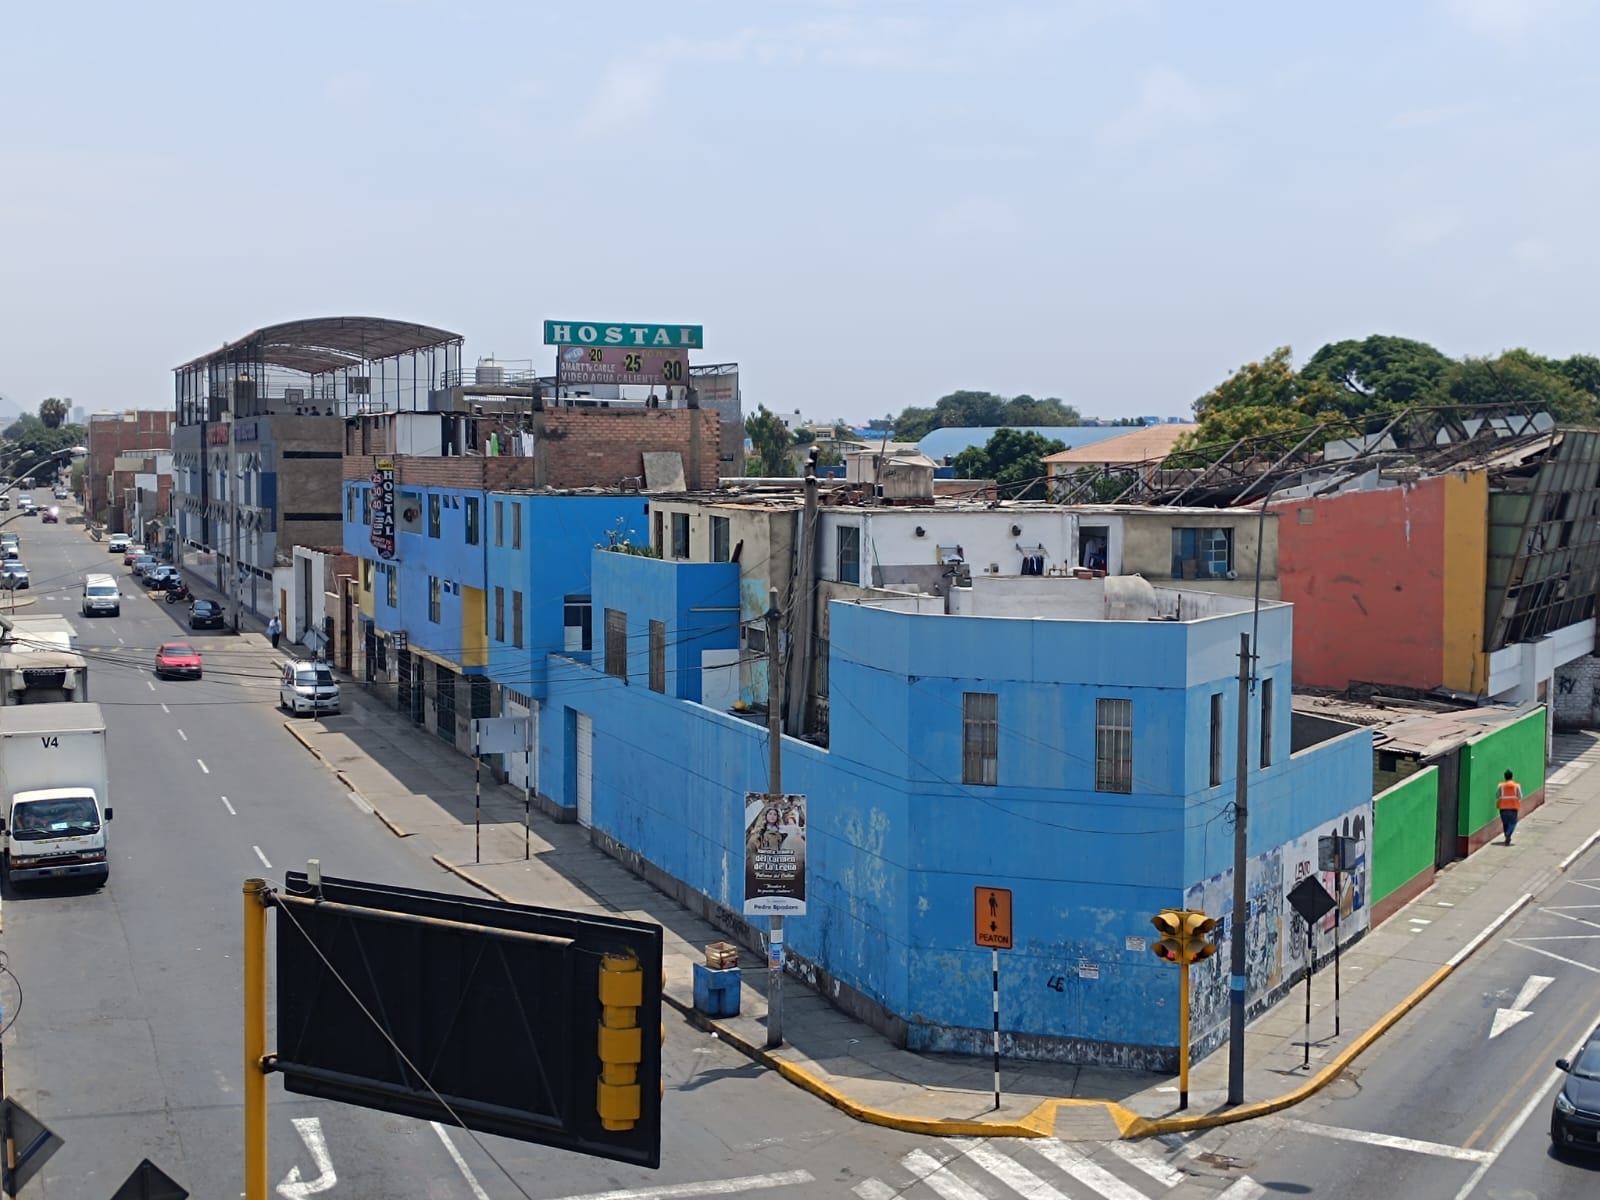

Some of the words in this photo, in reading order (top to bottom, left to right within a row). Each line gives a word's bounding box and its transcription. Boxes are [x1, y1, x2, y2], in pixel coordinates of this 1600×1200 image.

[552, 325, 696, 345] HOSTAL
[590, 349, 603, 362] 20
[625, 354, 642, 373] 25
[561, 372, 588, 382] VIDEO
[591, 373, 614, 383] AGUA
[616, 374, 660, 384] CALIENTE
[663, 360, 682, 381] 30
[383, 471, 393, 536] HOSTAL
[41, 736, 59, 749] V4
[978, 932, 1009, 944] PEATON
